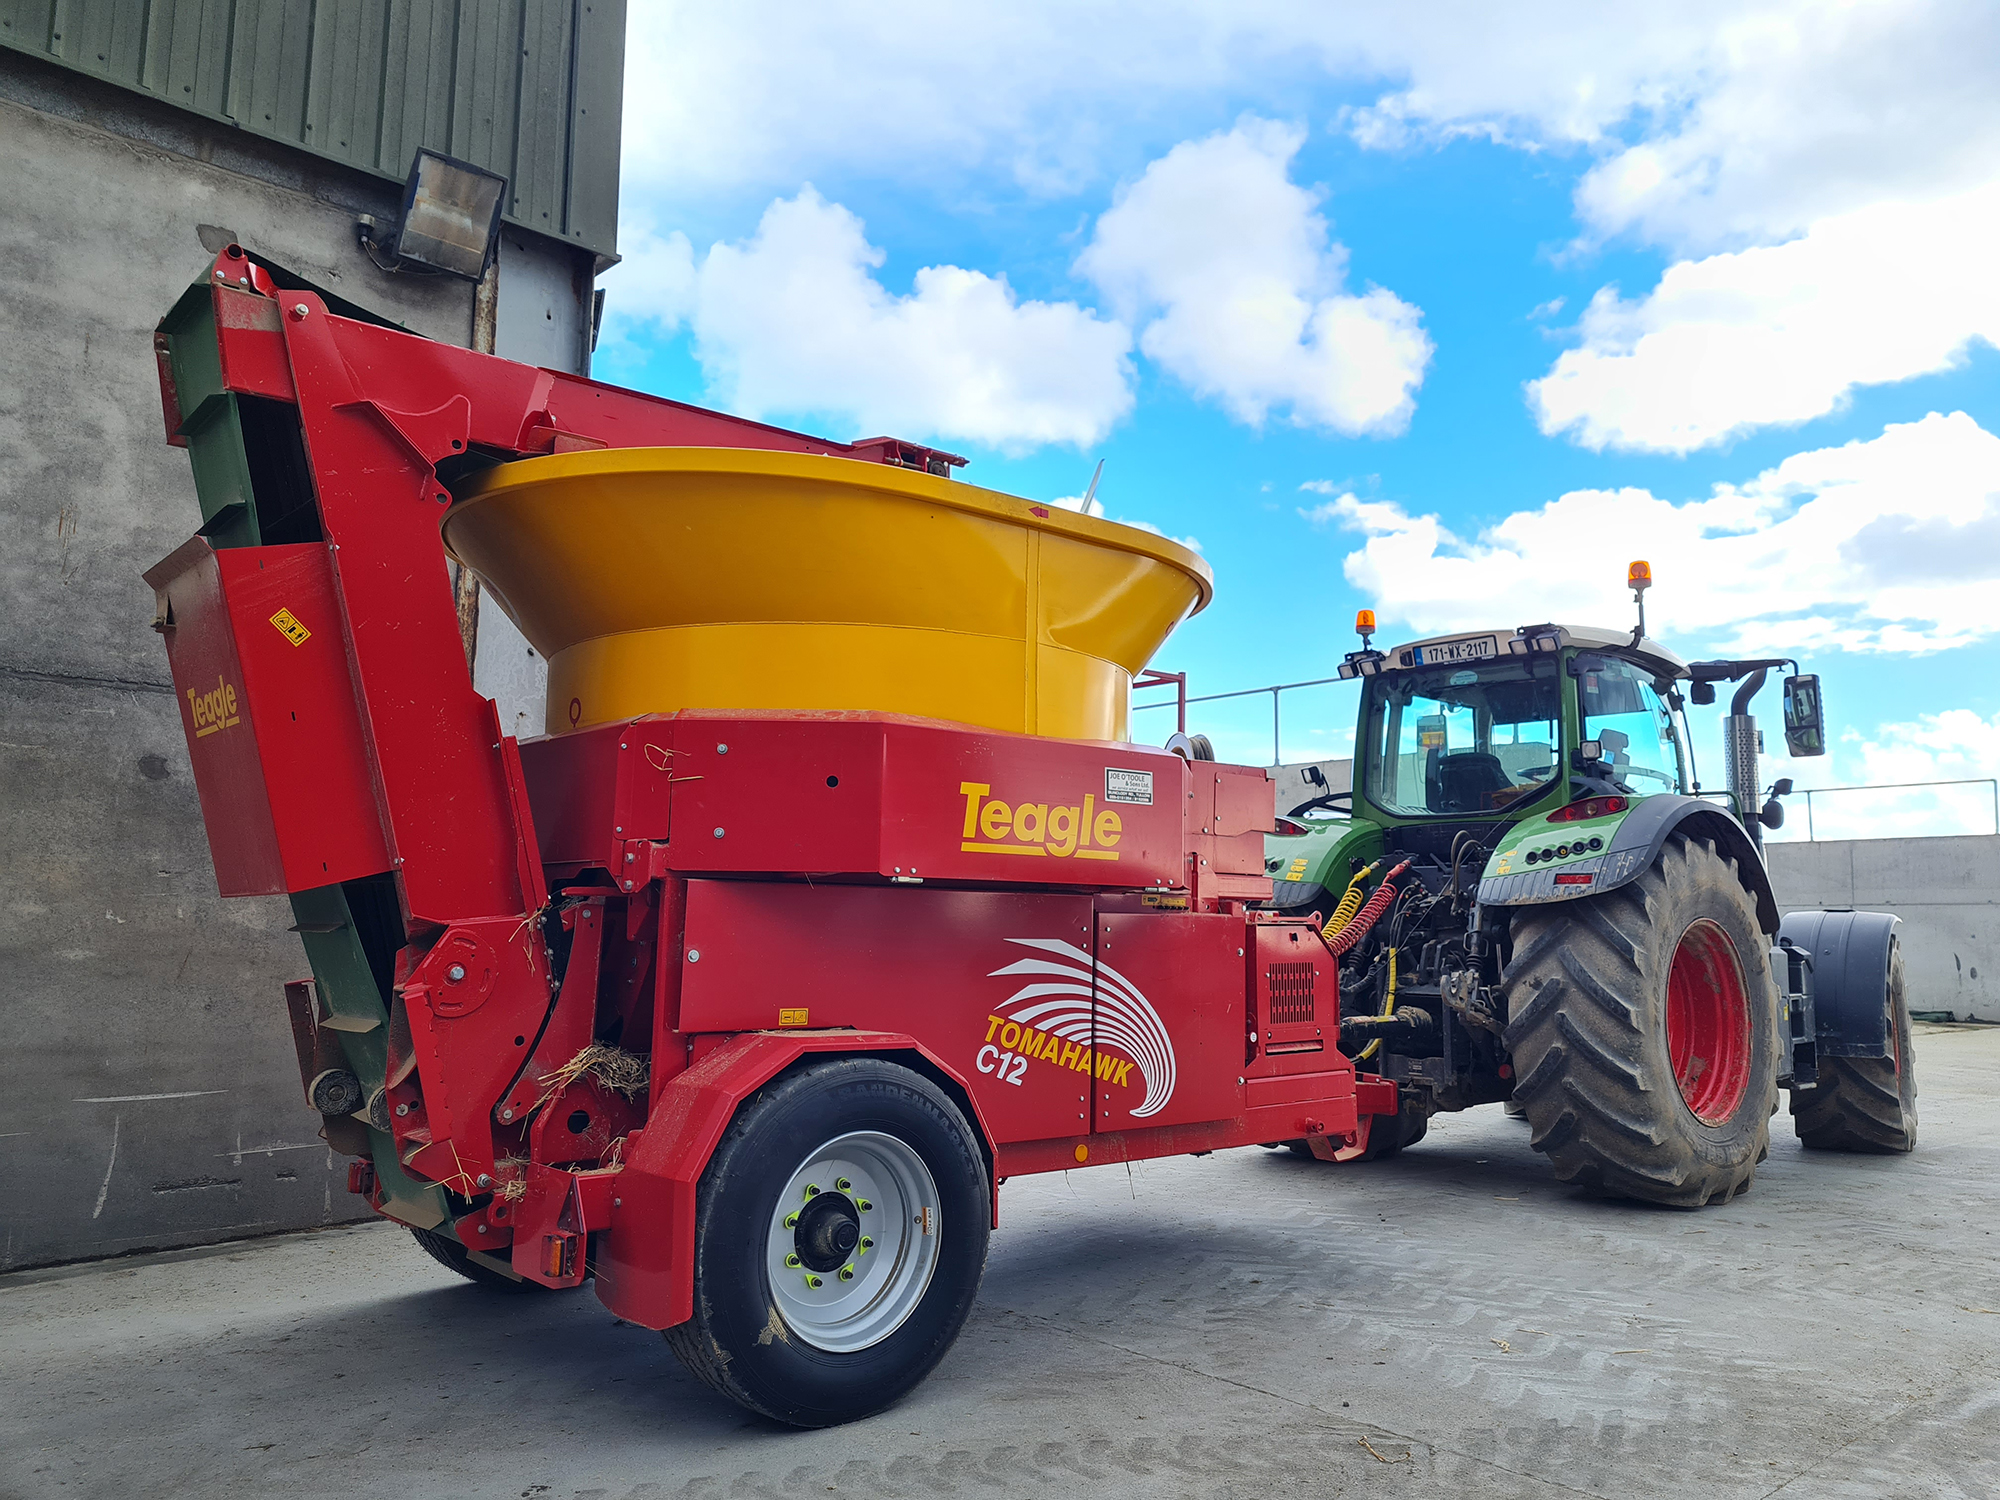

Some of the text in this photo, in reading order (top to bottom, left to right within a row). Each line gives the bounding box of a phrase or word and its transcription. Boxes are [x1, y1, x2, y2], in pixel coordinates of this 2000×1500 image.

[1429, 641, 1488, 662] 171-WX-2117
[186, 674, 238, 730] Teagle
[1121, 774, 1145, 782] O'TOOLE
[960, 781, 1122, 858] Teagle
[976, 1044, 1028, 1087] C12
[985, 1014, 1134, 1088] TOMAHAWK
